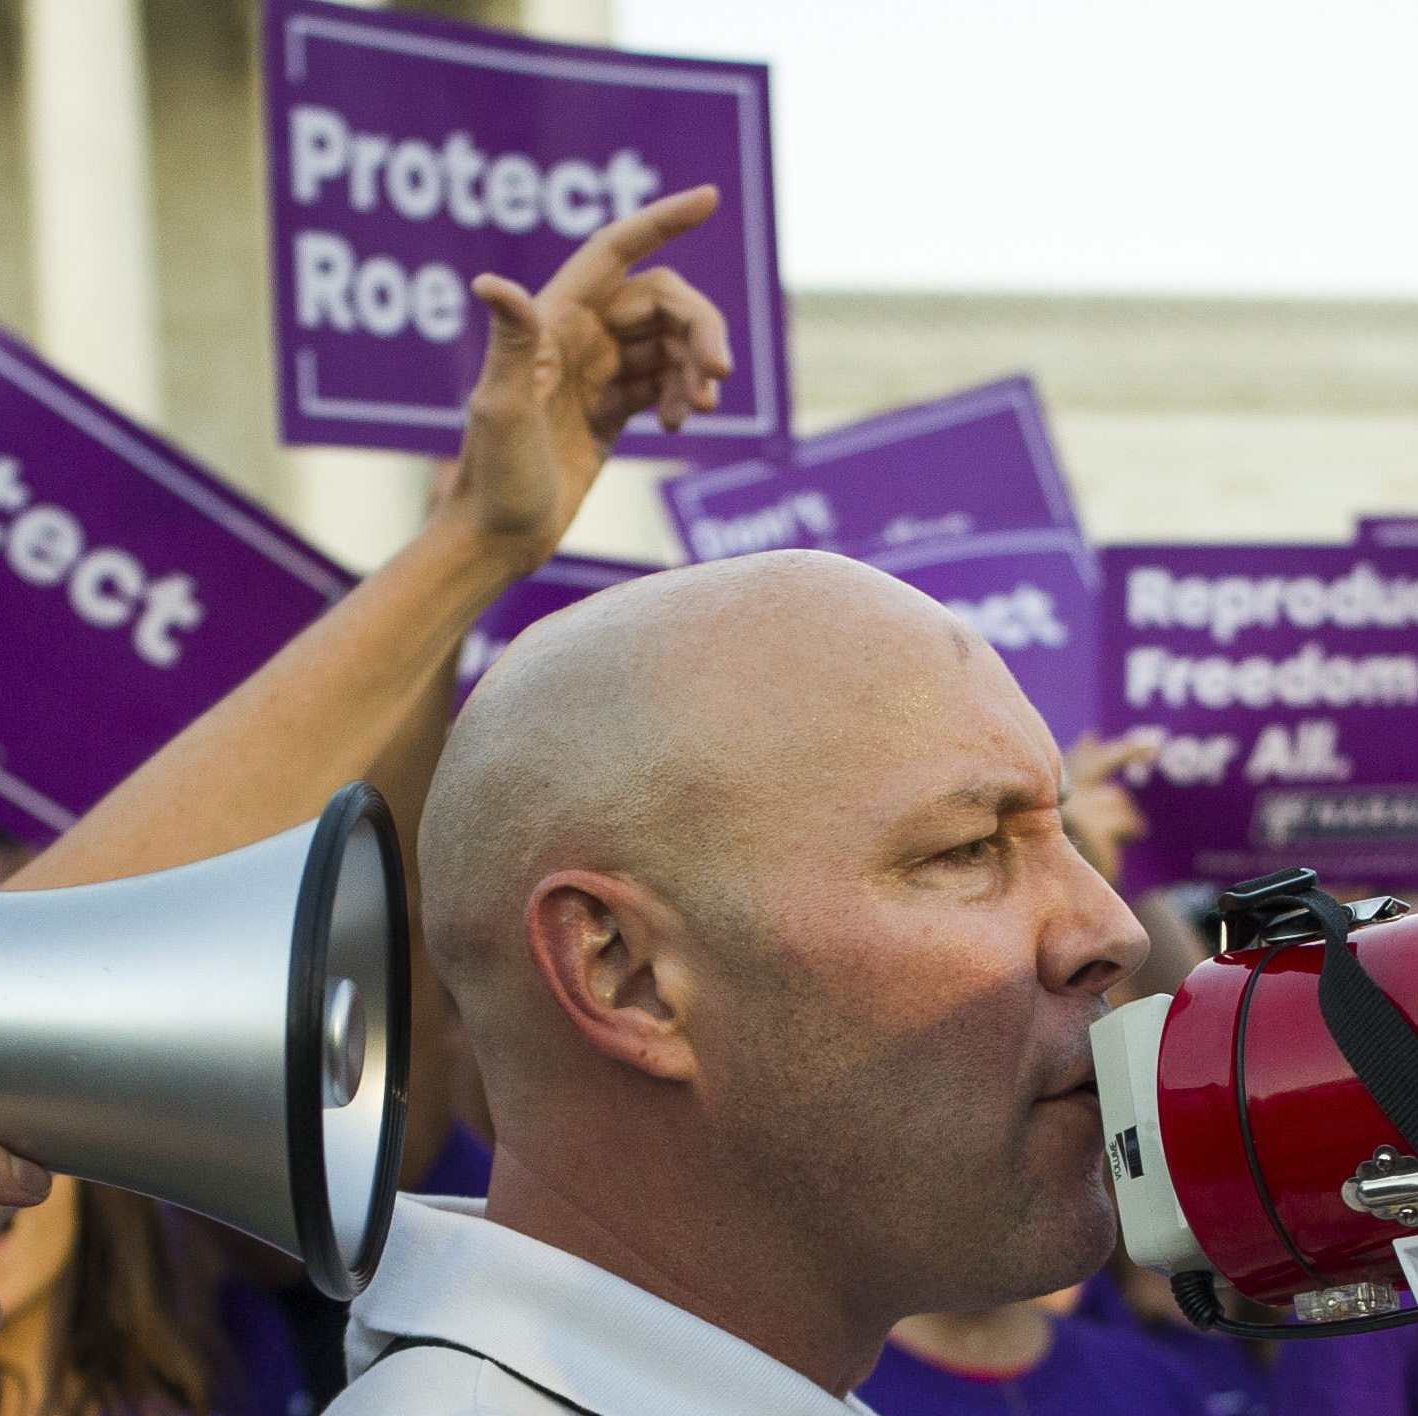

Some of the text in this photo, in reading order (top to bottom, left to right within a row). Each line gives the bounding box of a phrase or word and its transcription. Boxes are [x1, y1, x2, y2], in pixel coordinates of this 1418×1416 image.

[286, 104, 661, 240] Protect
[292, 231, 467, 345] Roe
[1245, 720, 1353, 784] All.
[1108, 1140, 1122, 1181] VOLUME
